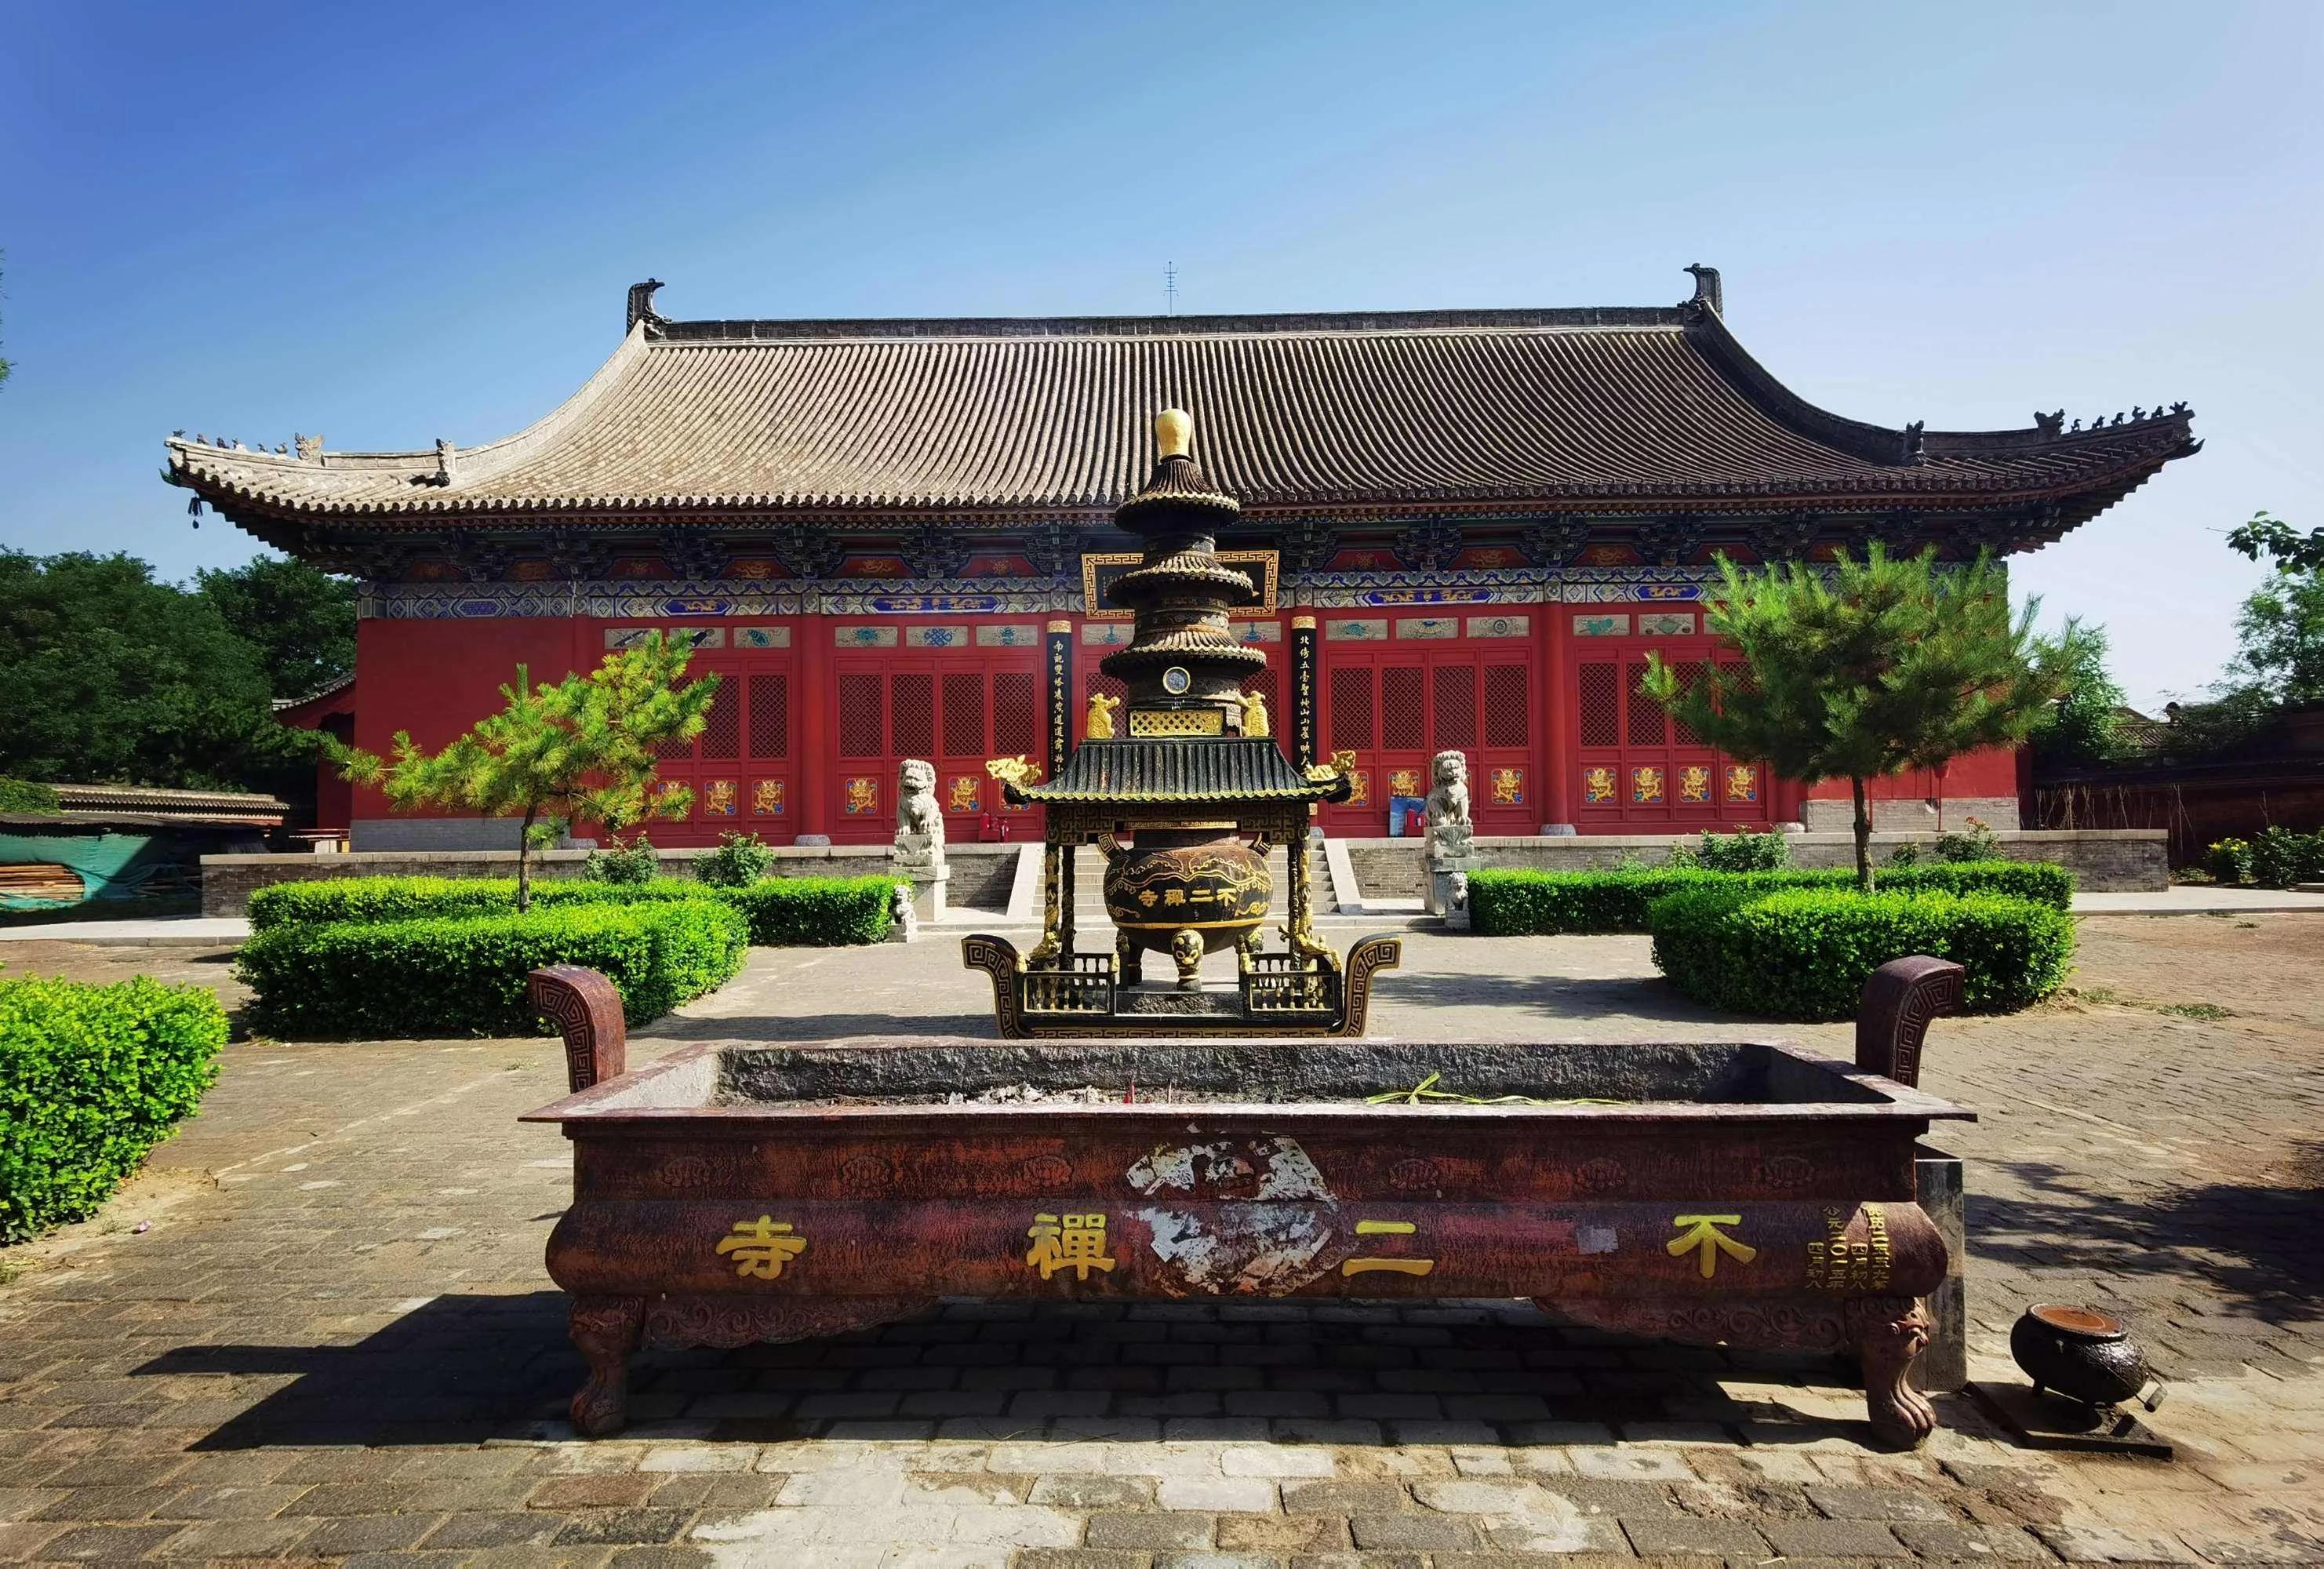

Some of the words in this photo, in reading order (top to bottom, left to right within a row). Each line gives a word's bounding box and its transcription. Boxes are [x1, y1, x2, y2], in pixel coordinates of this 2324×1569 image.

[1806, 1241, 1824, 1290] 四月初八
[1849, 1242, 1869, 1290] 四月初八
